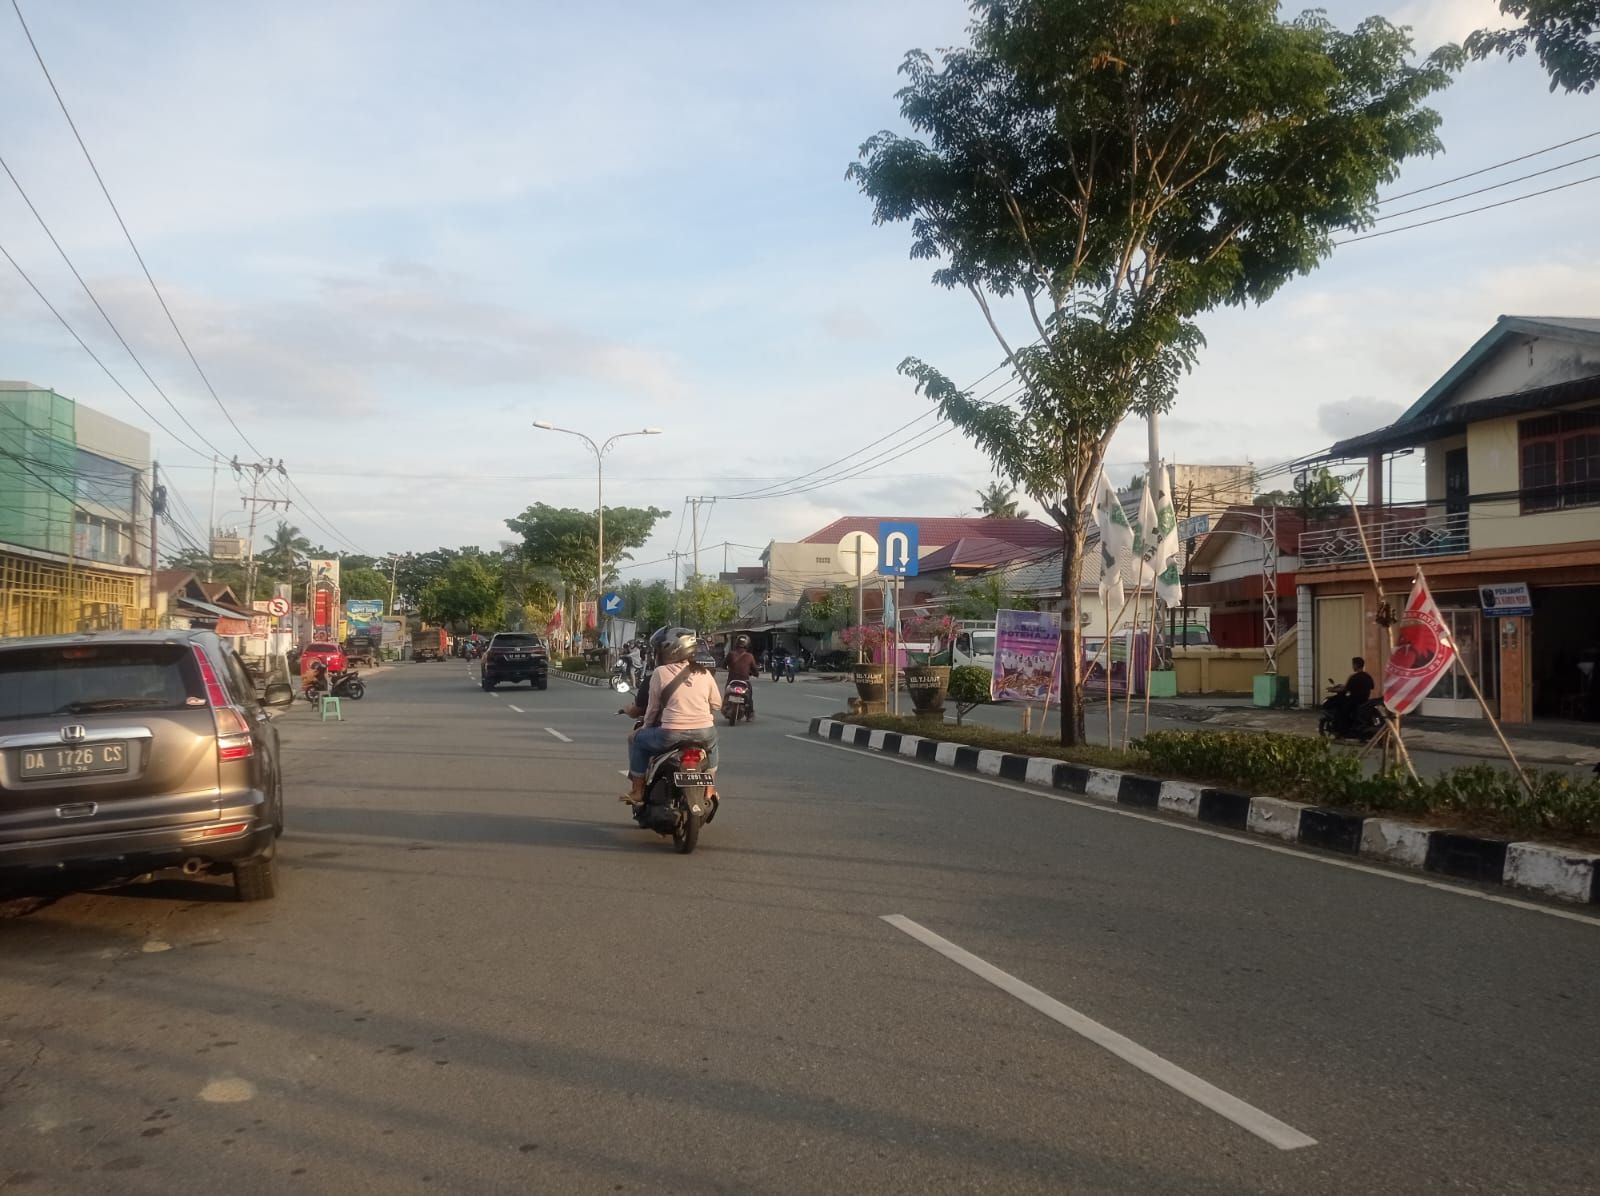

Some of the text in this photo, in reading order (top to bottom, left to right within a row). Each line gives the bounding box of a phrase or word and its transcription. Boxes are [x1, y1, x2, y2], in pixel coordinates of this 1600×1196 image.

[272, 601, 284, 613] S
[25, 746, 123, 769] DA 1726 CS
